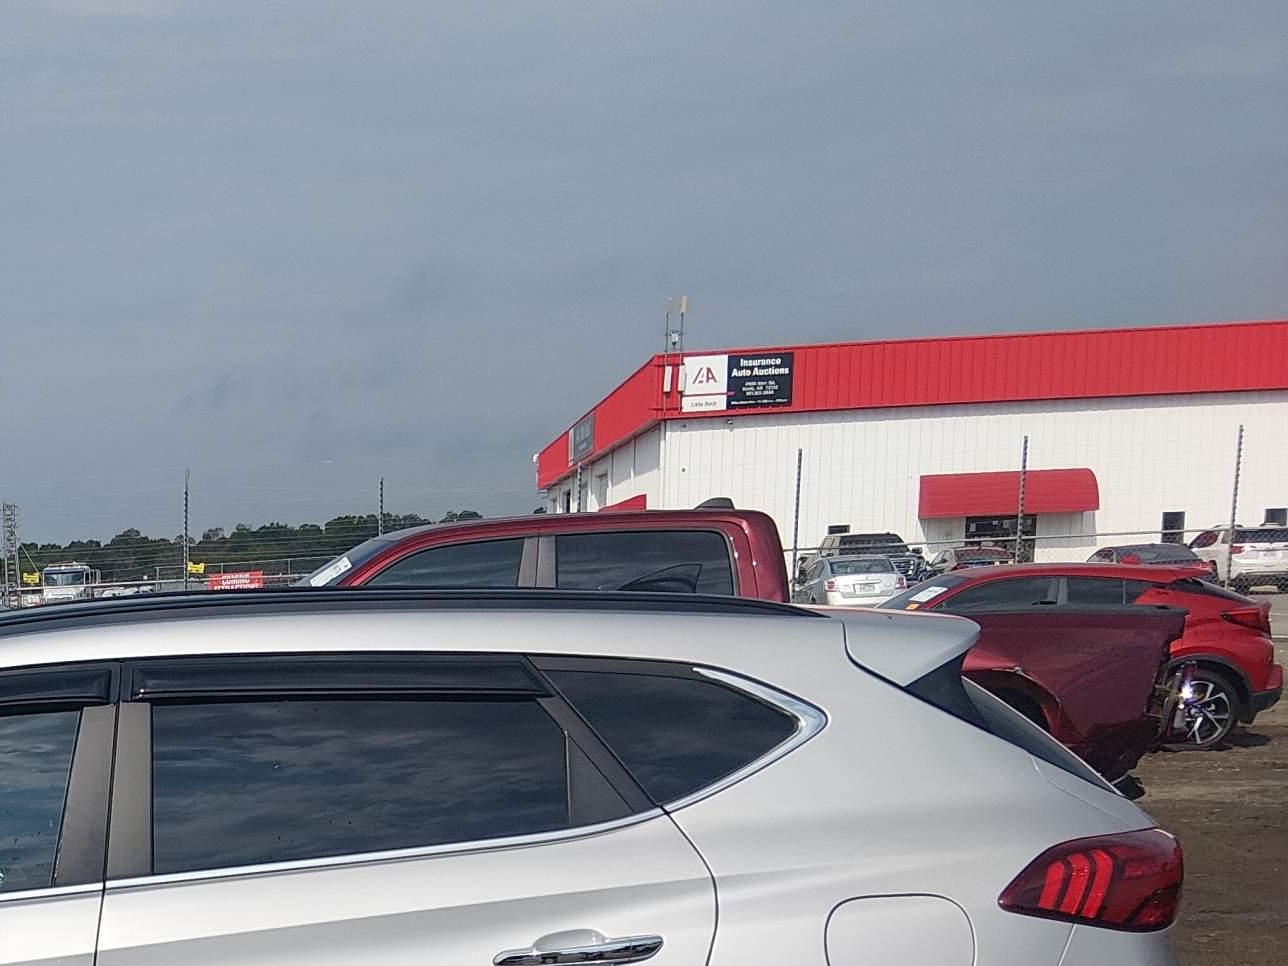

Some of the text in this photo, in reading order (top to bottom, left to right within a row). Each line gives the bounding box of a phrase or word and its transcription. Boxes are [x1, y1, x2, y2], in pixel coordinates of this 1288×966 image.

[740, 358, 781, 367] Insurance
[731, 366, 789, 377] Auto Auctions
